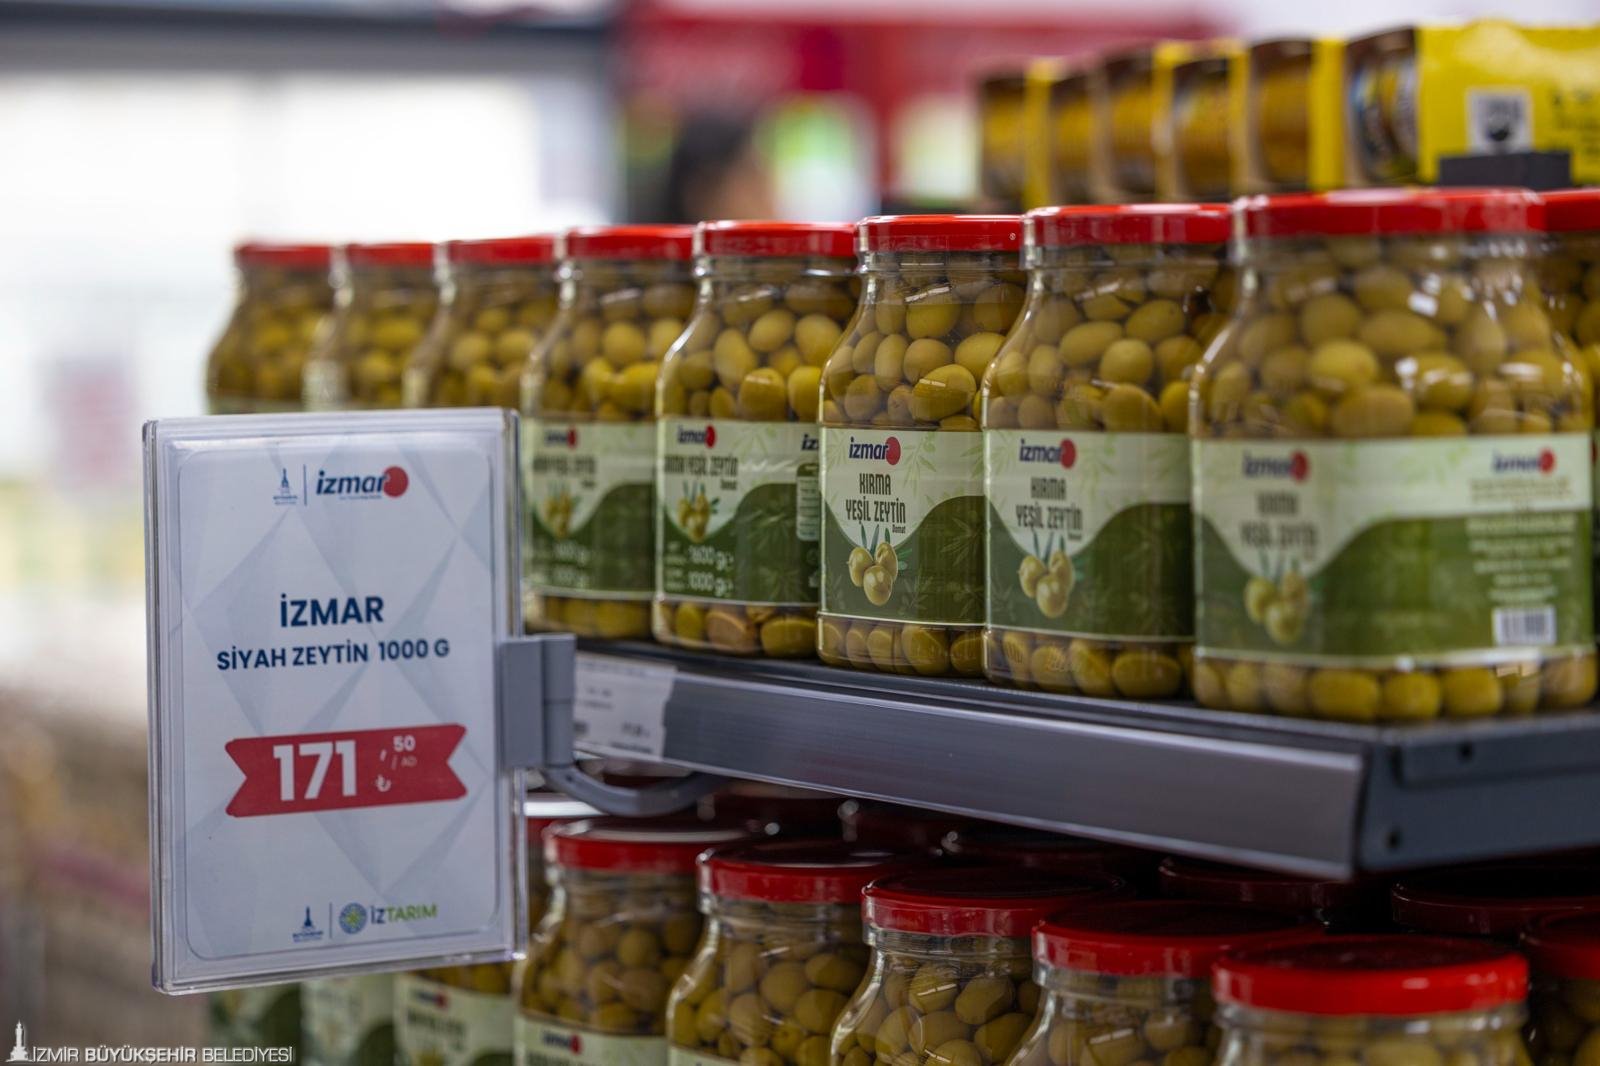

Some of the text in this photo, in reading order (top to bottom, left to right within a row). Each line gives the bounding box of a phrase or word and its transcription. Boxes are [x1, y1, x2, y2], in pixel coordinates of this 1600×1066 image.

[848, 436, 888, 460] izmar
[1019, 438, 1063, 463] izmar
[316, 470, 388, 495] izmar
[859, 473, 892, 495] KIRMA
[846, 496, 871, 525] YEŞİL
[874, 498, 906, 524] ZEYTİN
[280, 594, 384, 627] İZMAR
[216, 639, 450, 670] SİYAH ZEYTİN 1000 G
[393, 735, 416, 753] 50
[273, 740, 356, 801] 171
[371, 903, 437, 925] İZTARIM
